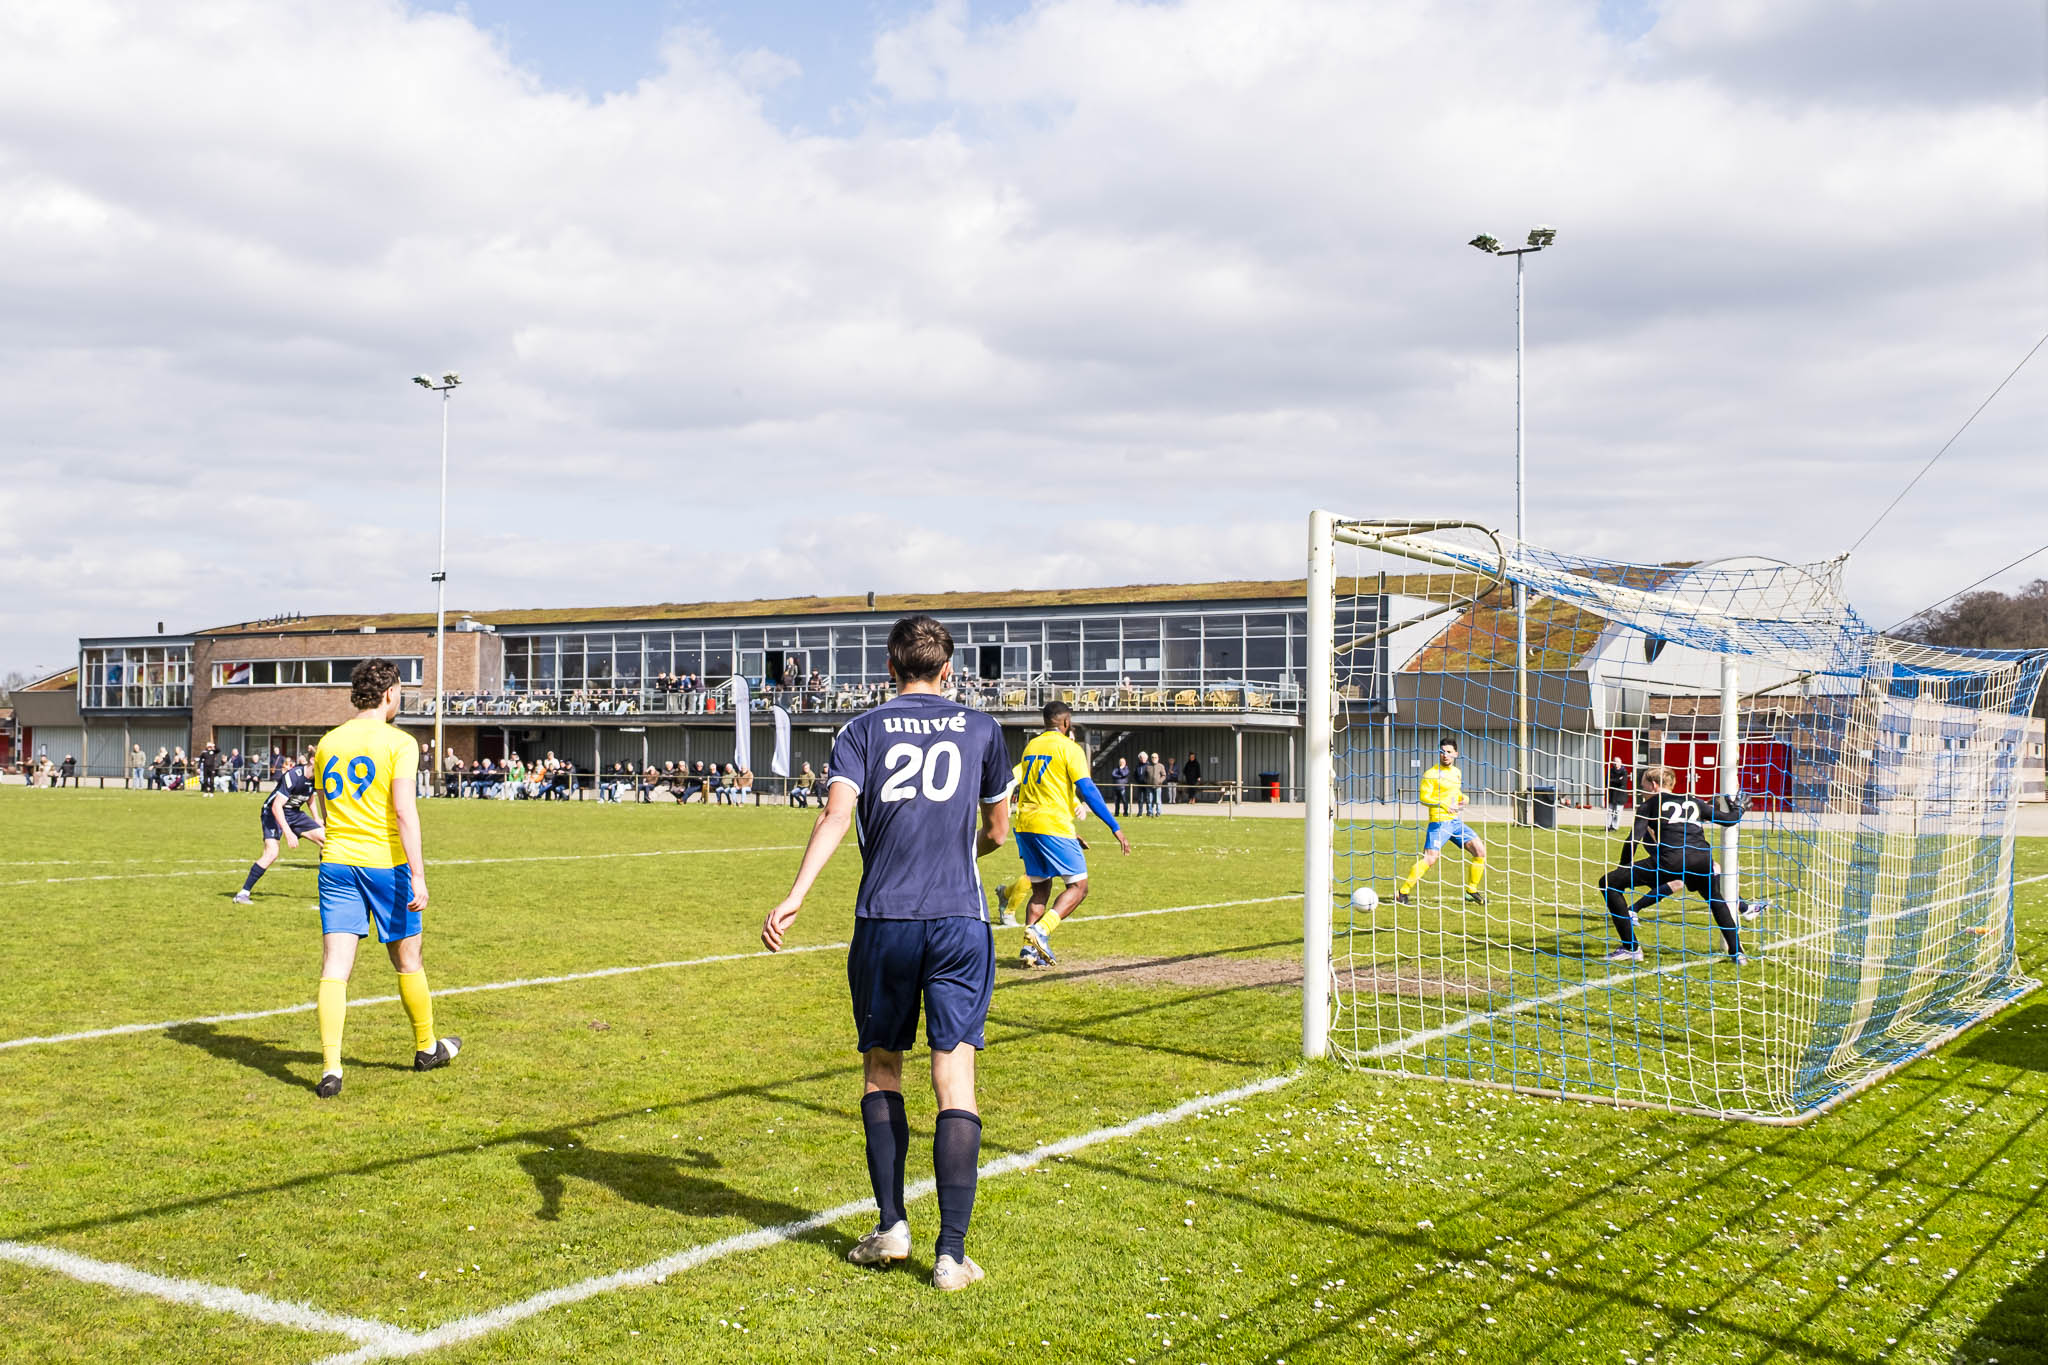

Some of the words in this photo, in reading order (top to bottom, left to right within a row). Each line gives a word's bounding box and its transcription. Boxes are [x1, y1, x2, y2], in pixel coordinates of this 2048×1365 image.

[883, 712, 966, 734] univé
[322, 755, 376, 801] 69
[881, 741, 961, 802] 20
[1023, 755, 1053, 785] 77
[1662, 801, 1702, 828] 22
